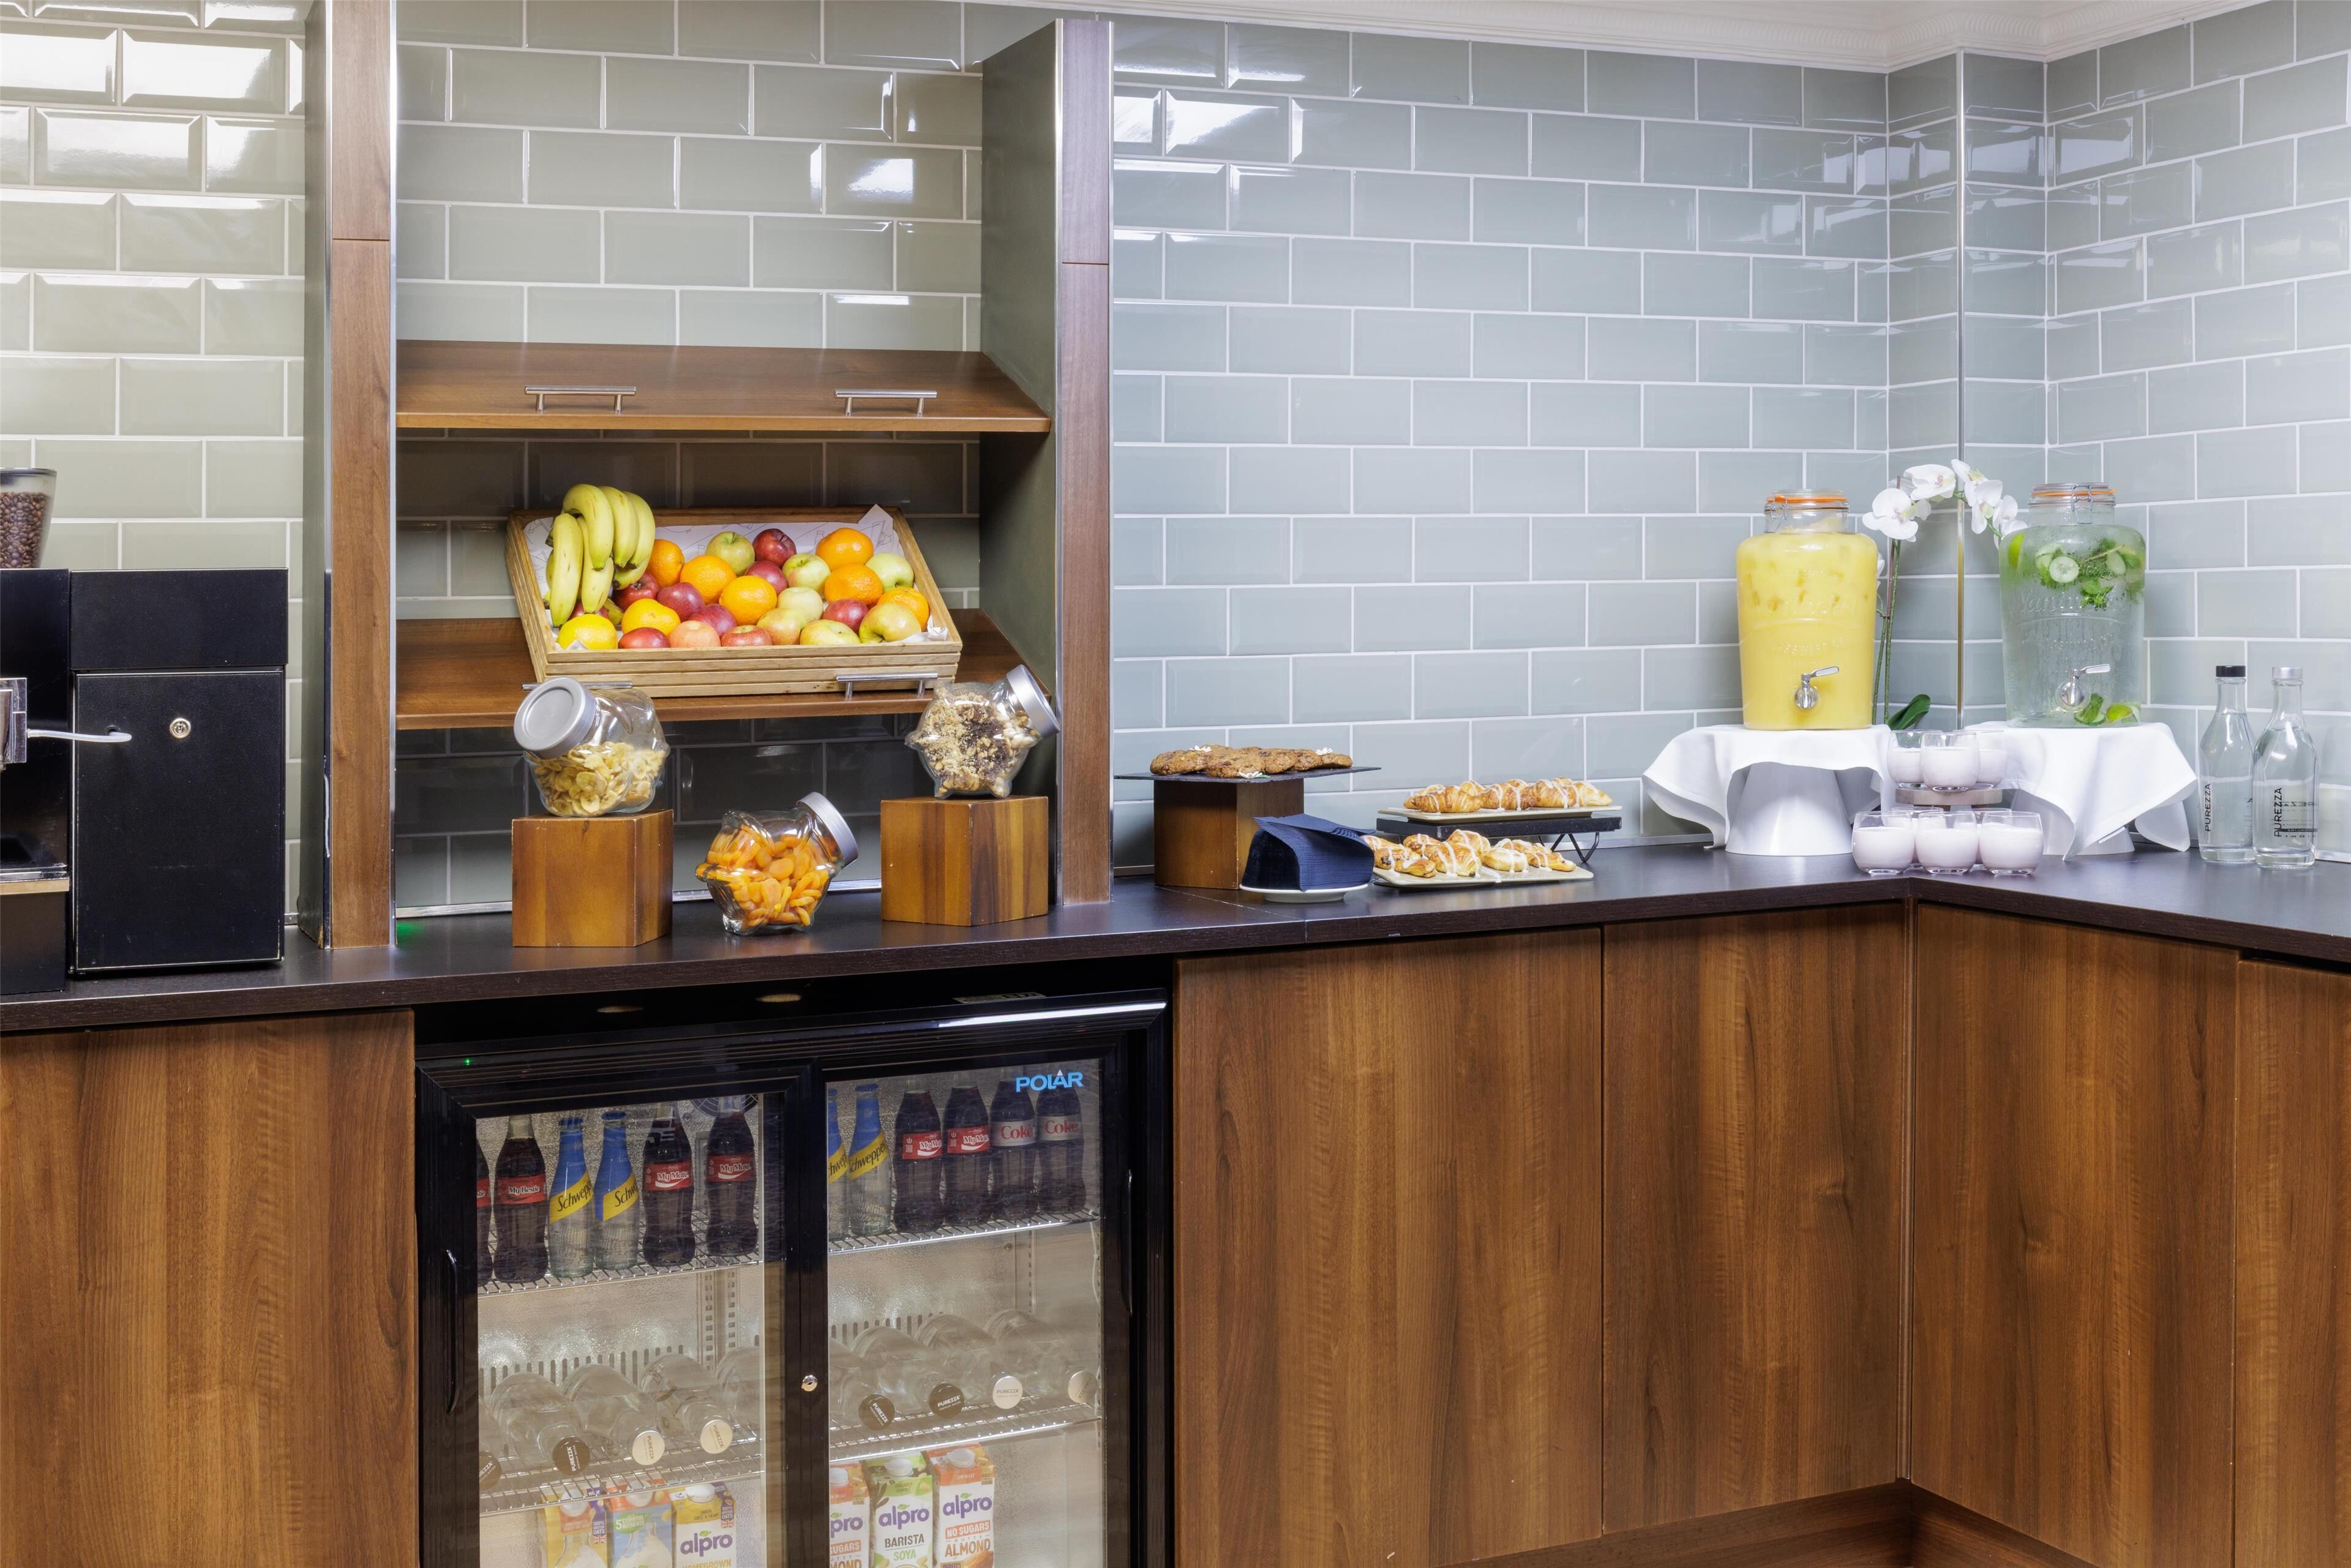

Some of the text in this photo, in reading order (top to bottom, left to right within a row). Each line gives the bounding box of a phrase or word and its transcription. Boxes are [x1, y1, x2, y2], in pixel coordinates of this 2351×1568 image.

[2274, 787, 2282, 838] PUREZZA
[1016, 1069, 1084, 1092] POLAR
[1000, 1125, 1033, 1139] Coke
[1044, 1120, 1078, 1134] Coke
[919, 1141, 931, 1150] My
[963, 1136, 975, 1145] My
[657, 1171, 689, 1182] My Mate
[720, 1163, 751, 1174] My Mate
[509, 1185, 540, 1195] My Bestie
[557, 1182, 592, 1212] Schwepp
[937, 1395, 960, 1407] PUREZZA
[872, 1402, 888, 1423] PUREZZA
[713, 1424, 724, 1447] PUREZZA
[567, 1446, 576, 1471] PUREZZA
[943, 1495, 992, 1518] alpro
[616, 1520, 622, 1530] 5
[879, 1506, 929, 1529] alpro
[830, 1517, 863, 1539] pro
[947, 1522, 989, 1538] NO SUGARS
[680, 1532, 733, 1557] alpro
[885, 1534, 924, 1548] BARISTA
[945, 1538, 991, 1558] ALMOND
[894, 1549, 916, 1561] SOYA
